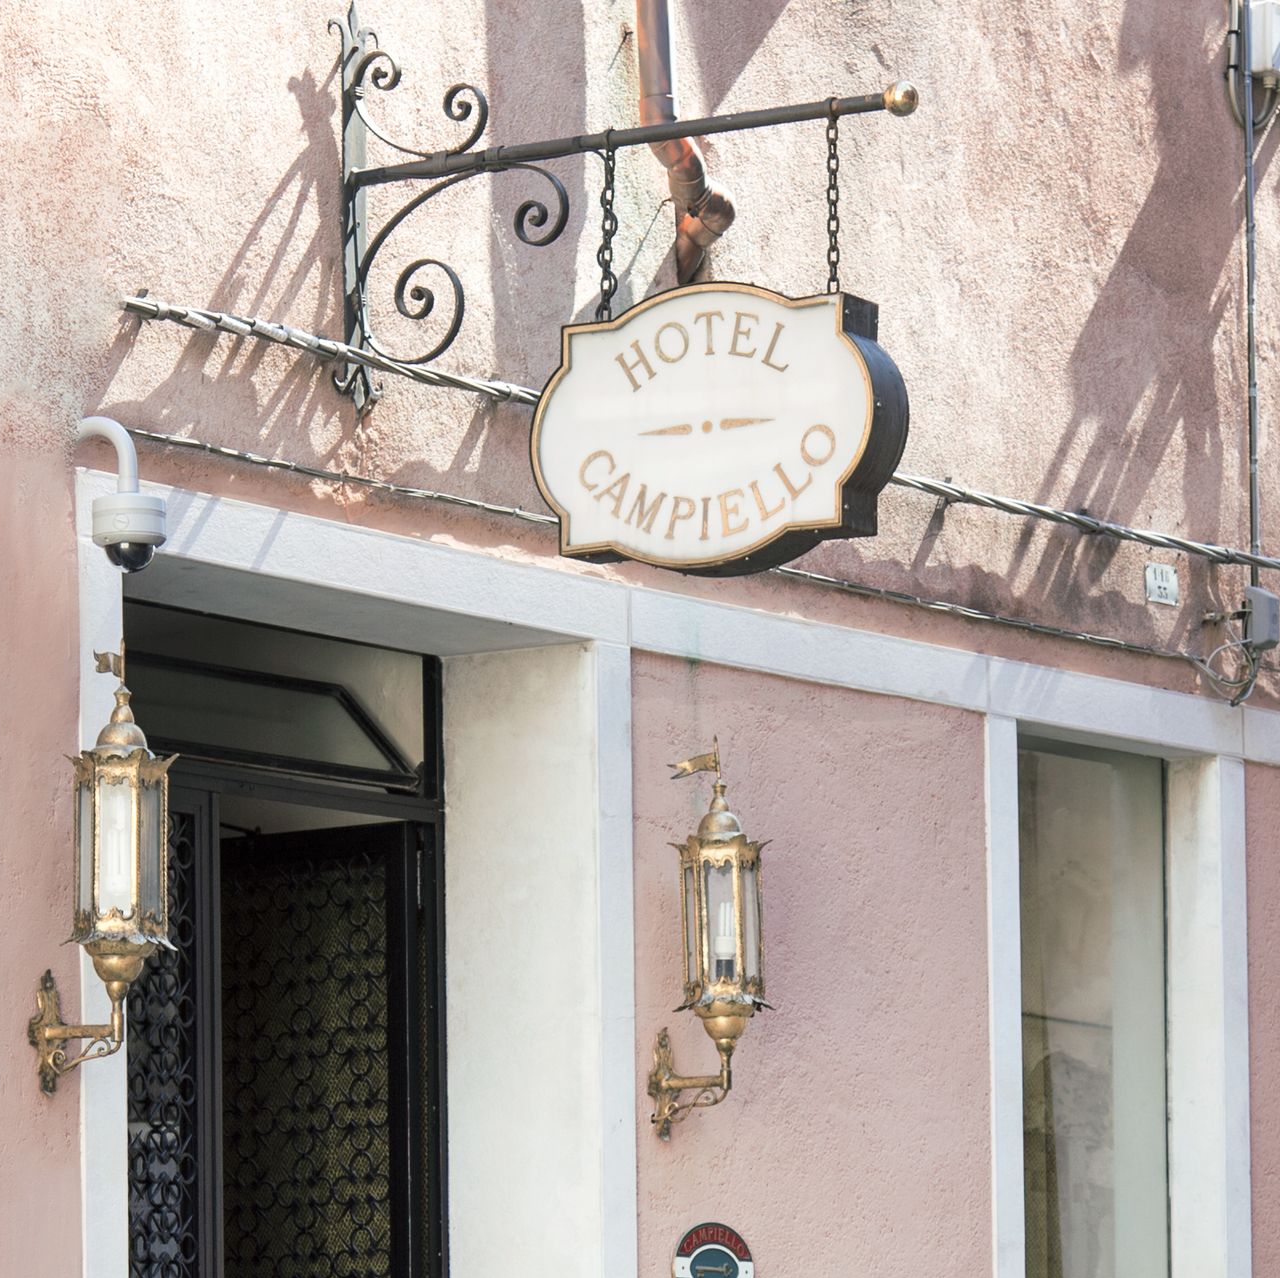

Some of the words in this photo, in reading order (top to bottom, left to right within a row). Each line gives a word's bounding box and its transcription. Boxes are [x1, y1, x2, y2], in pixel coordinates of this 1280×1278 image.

[615, 311, 789, 392] HOTEL
[579, 424, 836, 540] CAMPIELLO
[684, 1228, 746, 1257] CAMPIELLO
